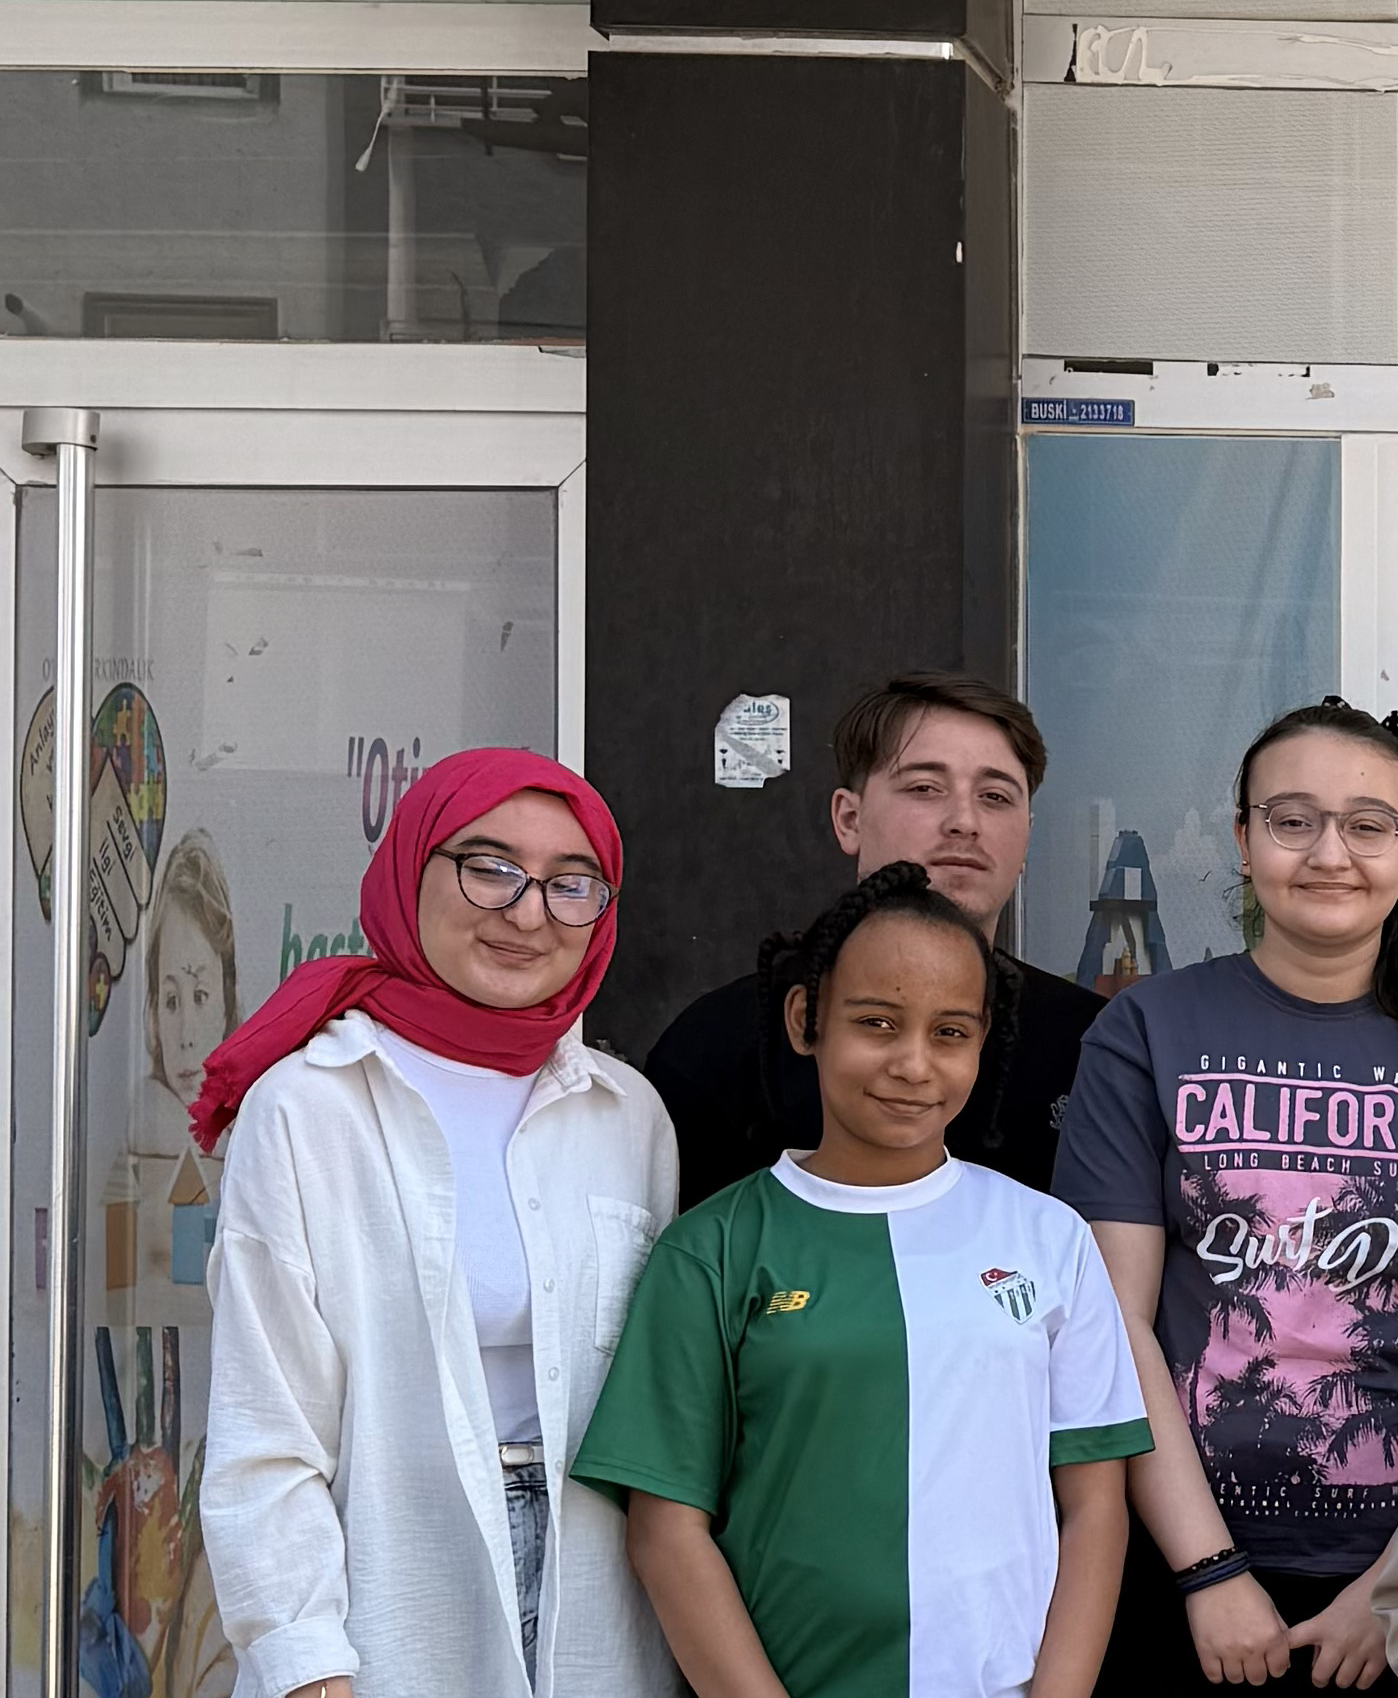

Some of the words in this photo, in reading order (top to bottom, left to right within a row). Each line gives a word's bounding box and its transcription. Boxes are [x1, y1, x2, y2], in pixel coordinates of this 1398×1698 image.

[1031, 400, 1067, 419] BUSKİ
[1200, 1054, 1342, 1079] GIGANTIC
[1204, 1152, 1259, 1171] LONG
[1281, 1154, 1351, 1174] BEACH
[1220, 1485, 1287, 1497] ENTIC
